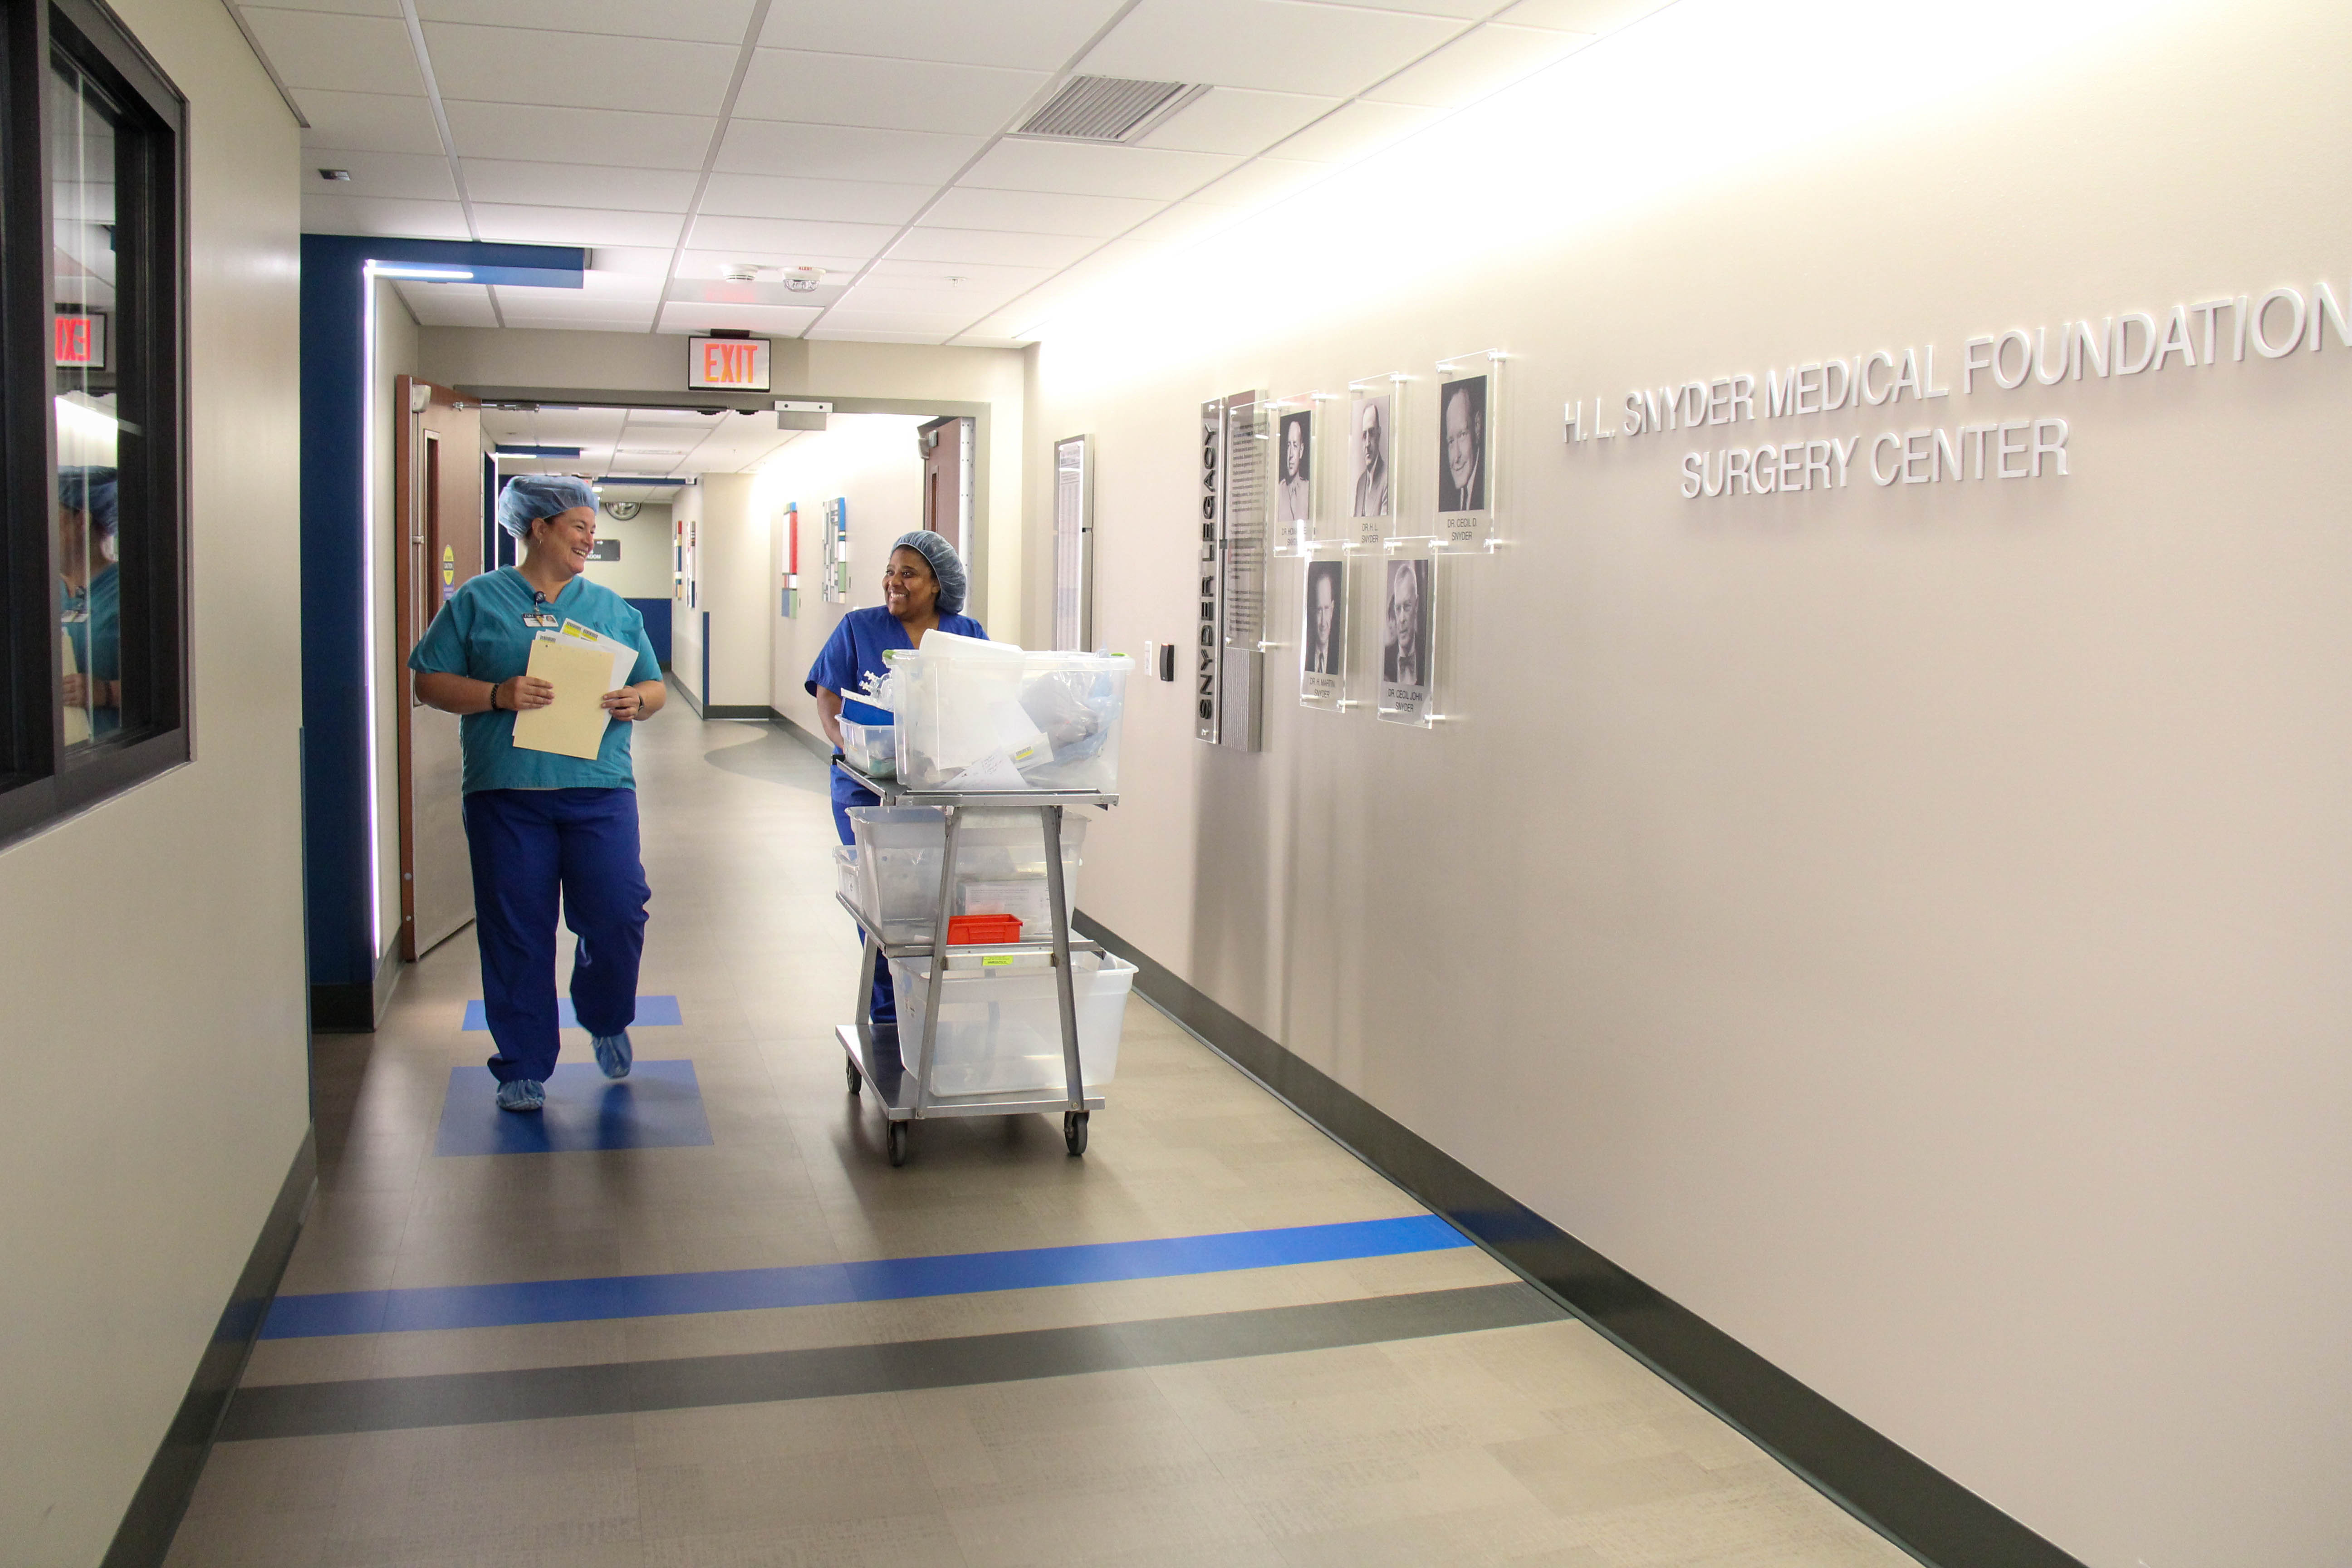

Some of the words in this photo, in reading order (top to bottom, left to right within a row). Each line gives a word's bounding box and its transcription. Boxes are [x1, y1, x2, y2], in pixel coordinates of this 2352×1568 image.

[704, 343, 759, 384] EXIT
[1563, 401, 1588, 443] H.
[1594, 398, 1615, 439] L.
[1623, 374, 1755, 436] SNYDER
[1764, 345, 1950, 418] MEDICAL
[1963, 278, 2352, 395] FOUNDATION
[1681, 435, 1860, 500] SURGERY
[1870, 418, 2070, 487] CENTER
[1202, 423, 1217, 562] LEGACY
[1457, 518, 1471, 527] CECIL
[1362, 534, 1379, 543] SNYDER
[1452, 531, 1472, 540] SNYDER
[1200, 575, 1214, 720] SNYDER
[1314, 689, 1330, 698] SNYDER
[1396, 690, 1409, 700] CECIL
[1410, 691, 1422, 701] JOHN
[1396, 701, 1414, 713] SNYDER
